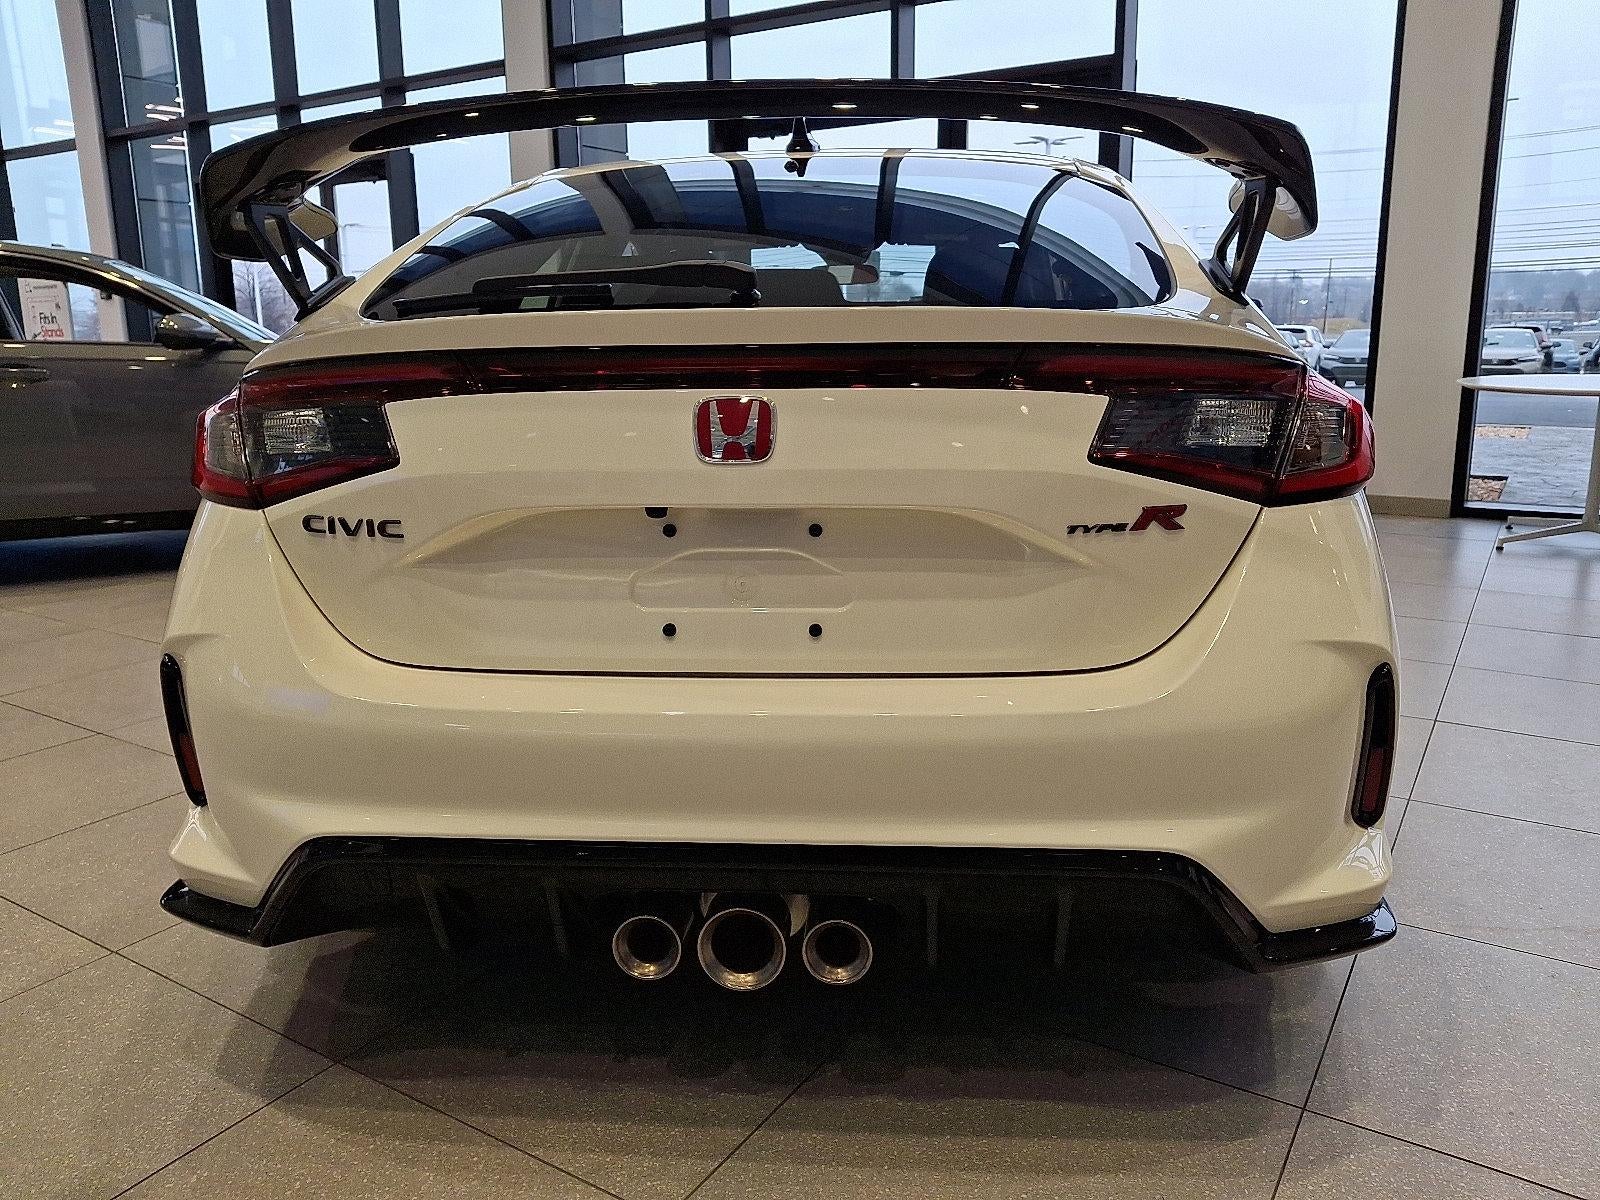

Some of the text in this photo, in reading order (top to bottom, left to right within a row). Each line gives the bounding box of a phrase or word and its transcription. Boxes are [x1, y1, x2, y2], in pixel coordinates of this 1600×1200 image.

[302, 514, 405, 539] CIVIC
[1066, 503, 1188, 535] TYPE R
